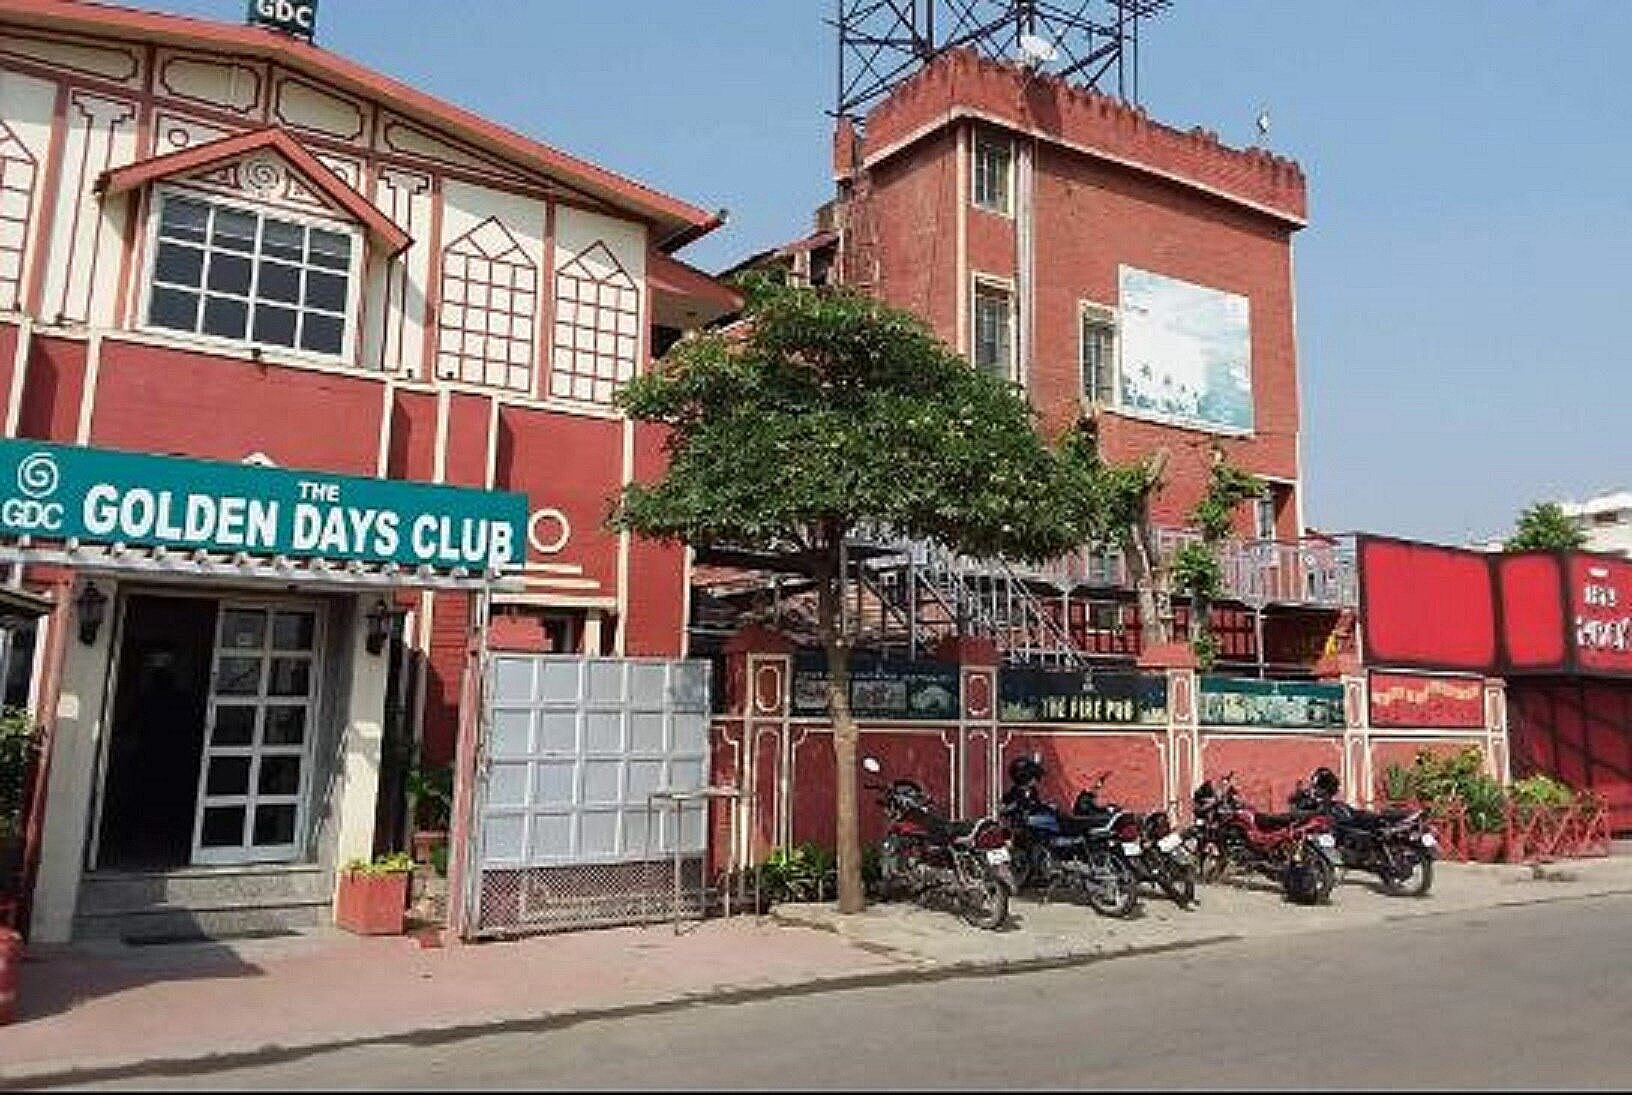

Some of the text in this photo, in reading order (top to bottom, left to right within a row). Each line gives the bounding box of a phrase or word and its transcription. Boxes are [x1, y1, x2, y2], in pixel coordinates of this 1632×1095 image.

[257, 0, 313, 28] GDC
[298, 481, 341, 502] THE
[1, 499, 64, 529] GDC
[83, 484, 514, 564] GOLDEN DAYS CLUB
